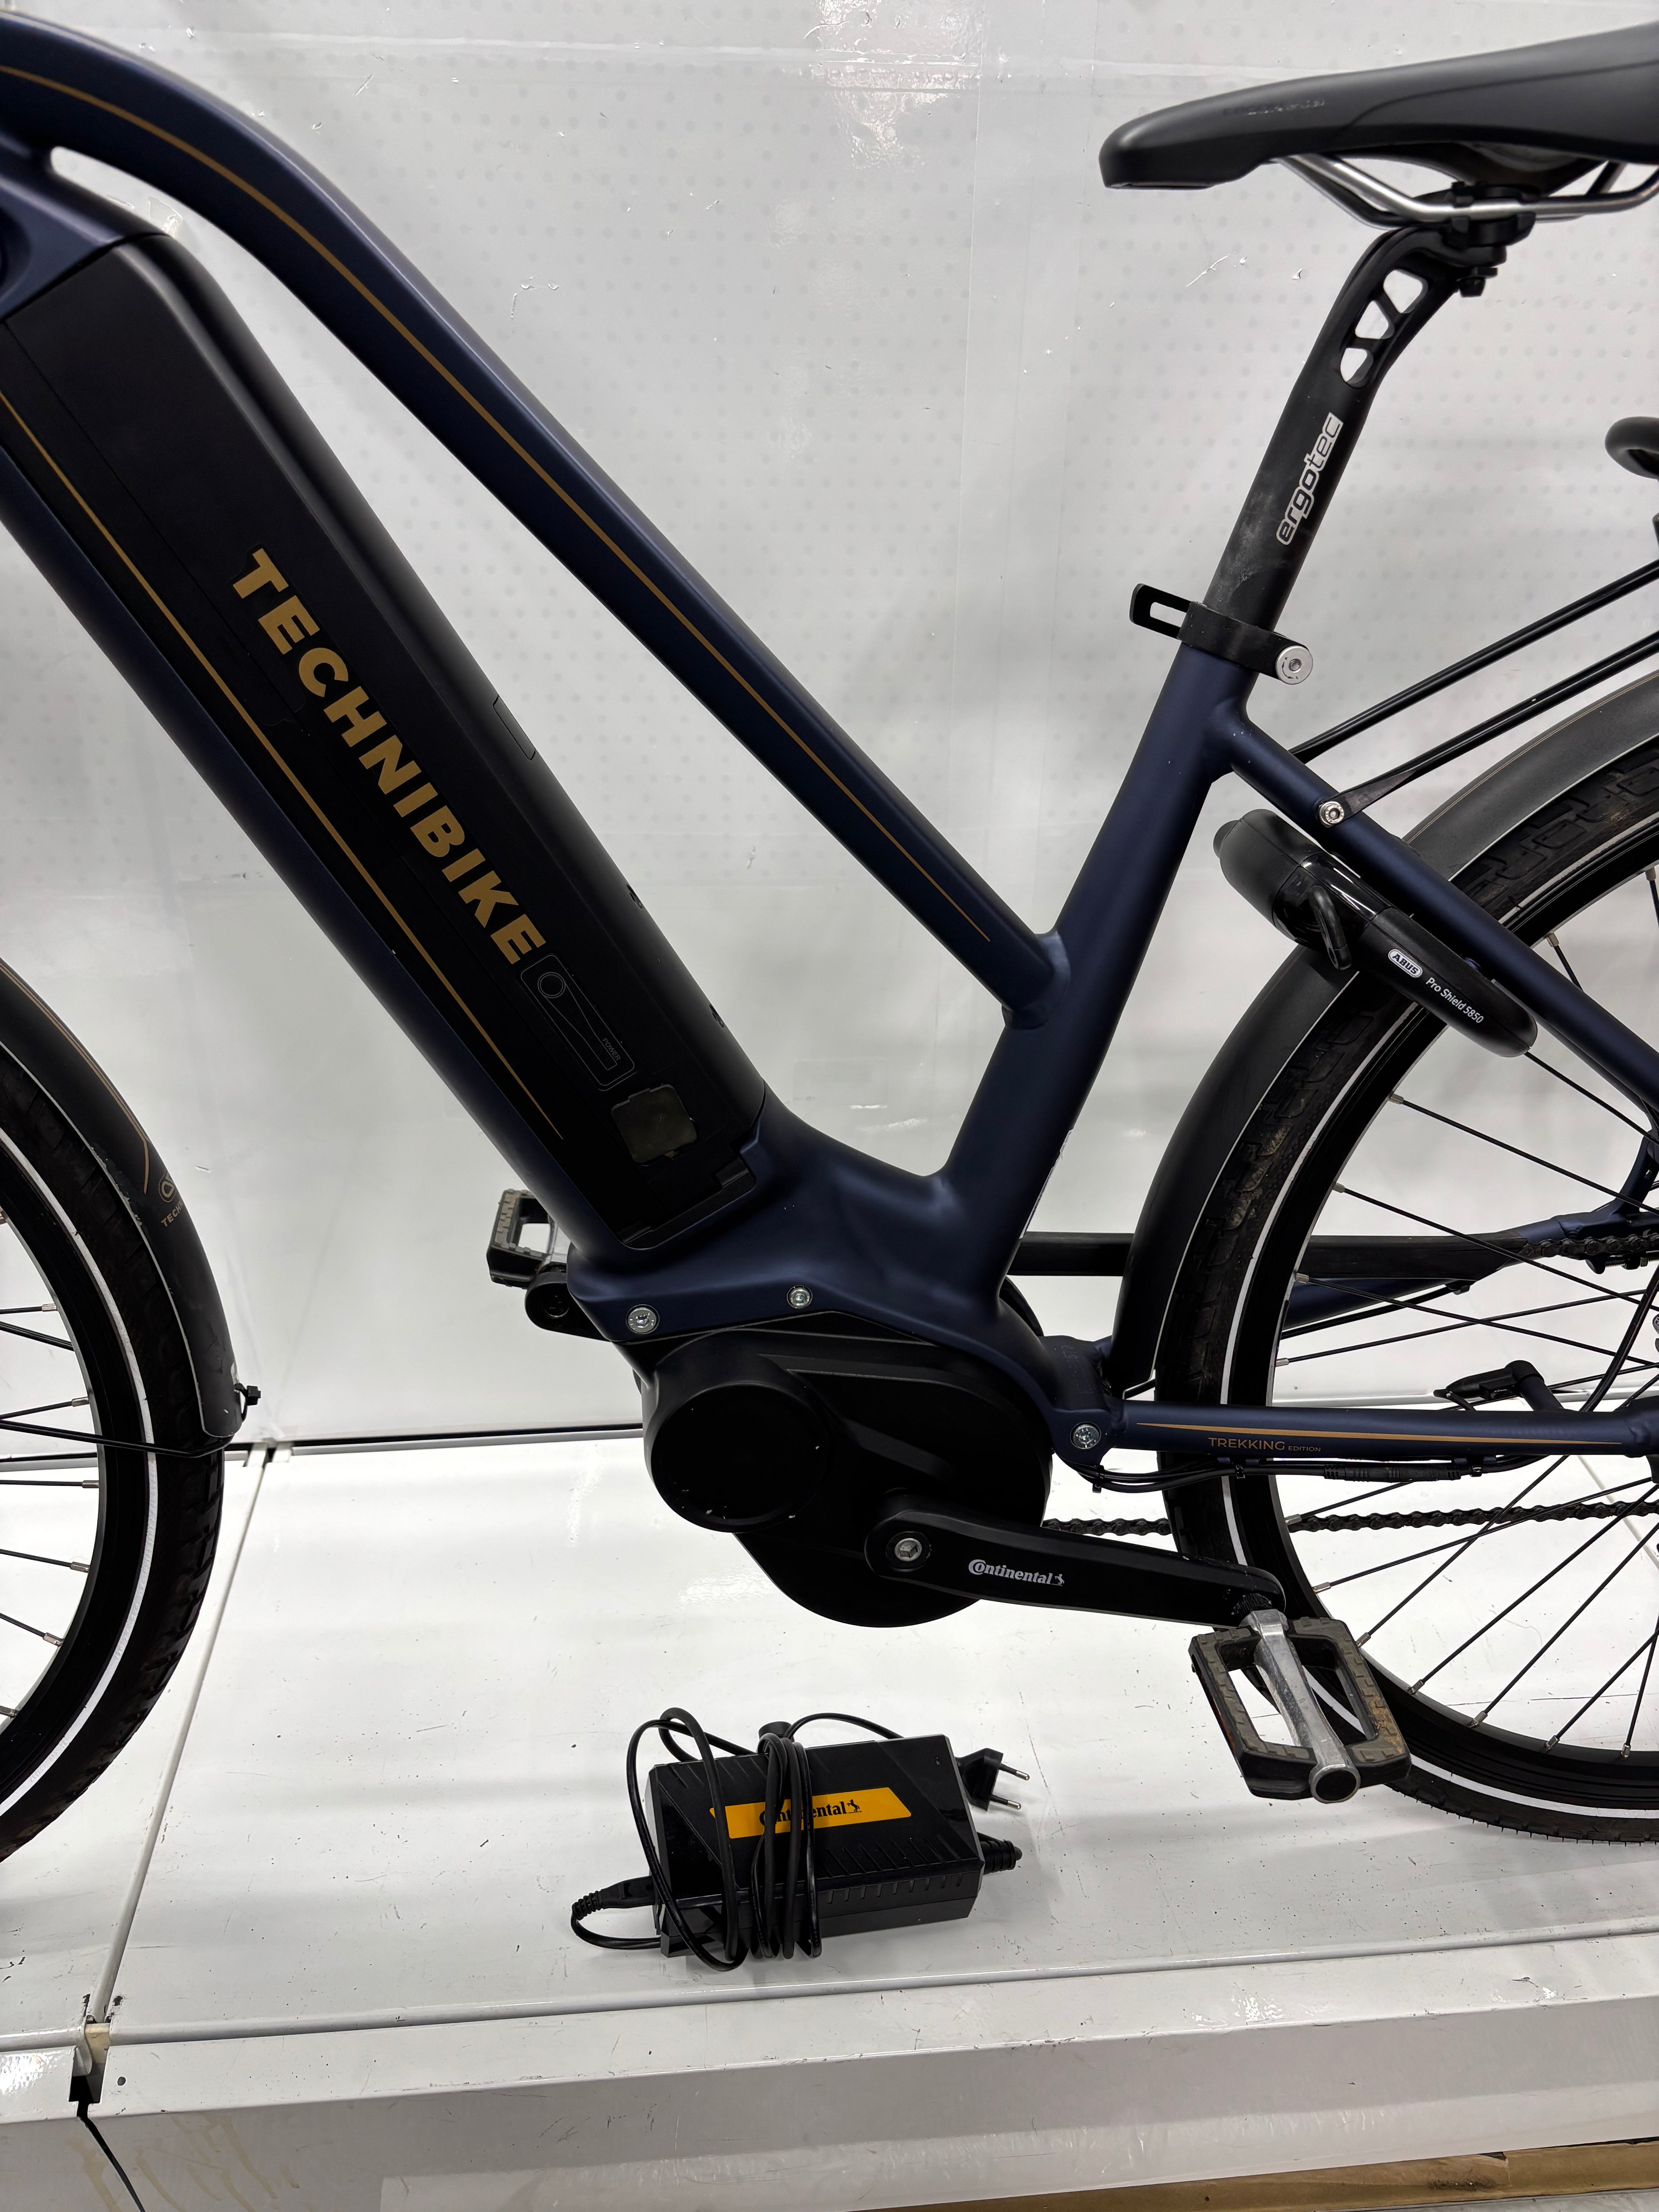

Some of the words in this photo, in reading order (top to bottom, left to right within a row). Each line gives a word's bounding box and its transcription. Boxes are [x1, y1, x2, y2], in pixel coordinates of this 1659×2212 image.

[1278, 414, 1342, 544] ergotec
[233, 549, 545, 965] TECHNIBIKE
[1392, 953, 1420, 975] ABUS
[1426, 977, 1441, 992] Pro
[1440, 988, 1467, 1011] Shield
[1463, 1006, 1484, 1023] 5850
[602, 1038, 621, 1061] POWER
[1208, 1437, 1285, 1451] TREKKING
[968, 1559, 1053, 1585] Continental
